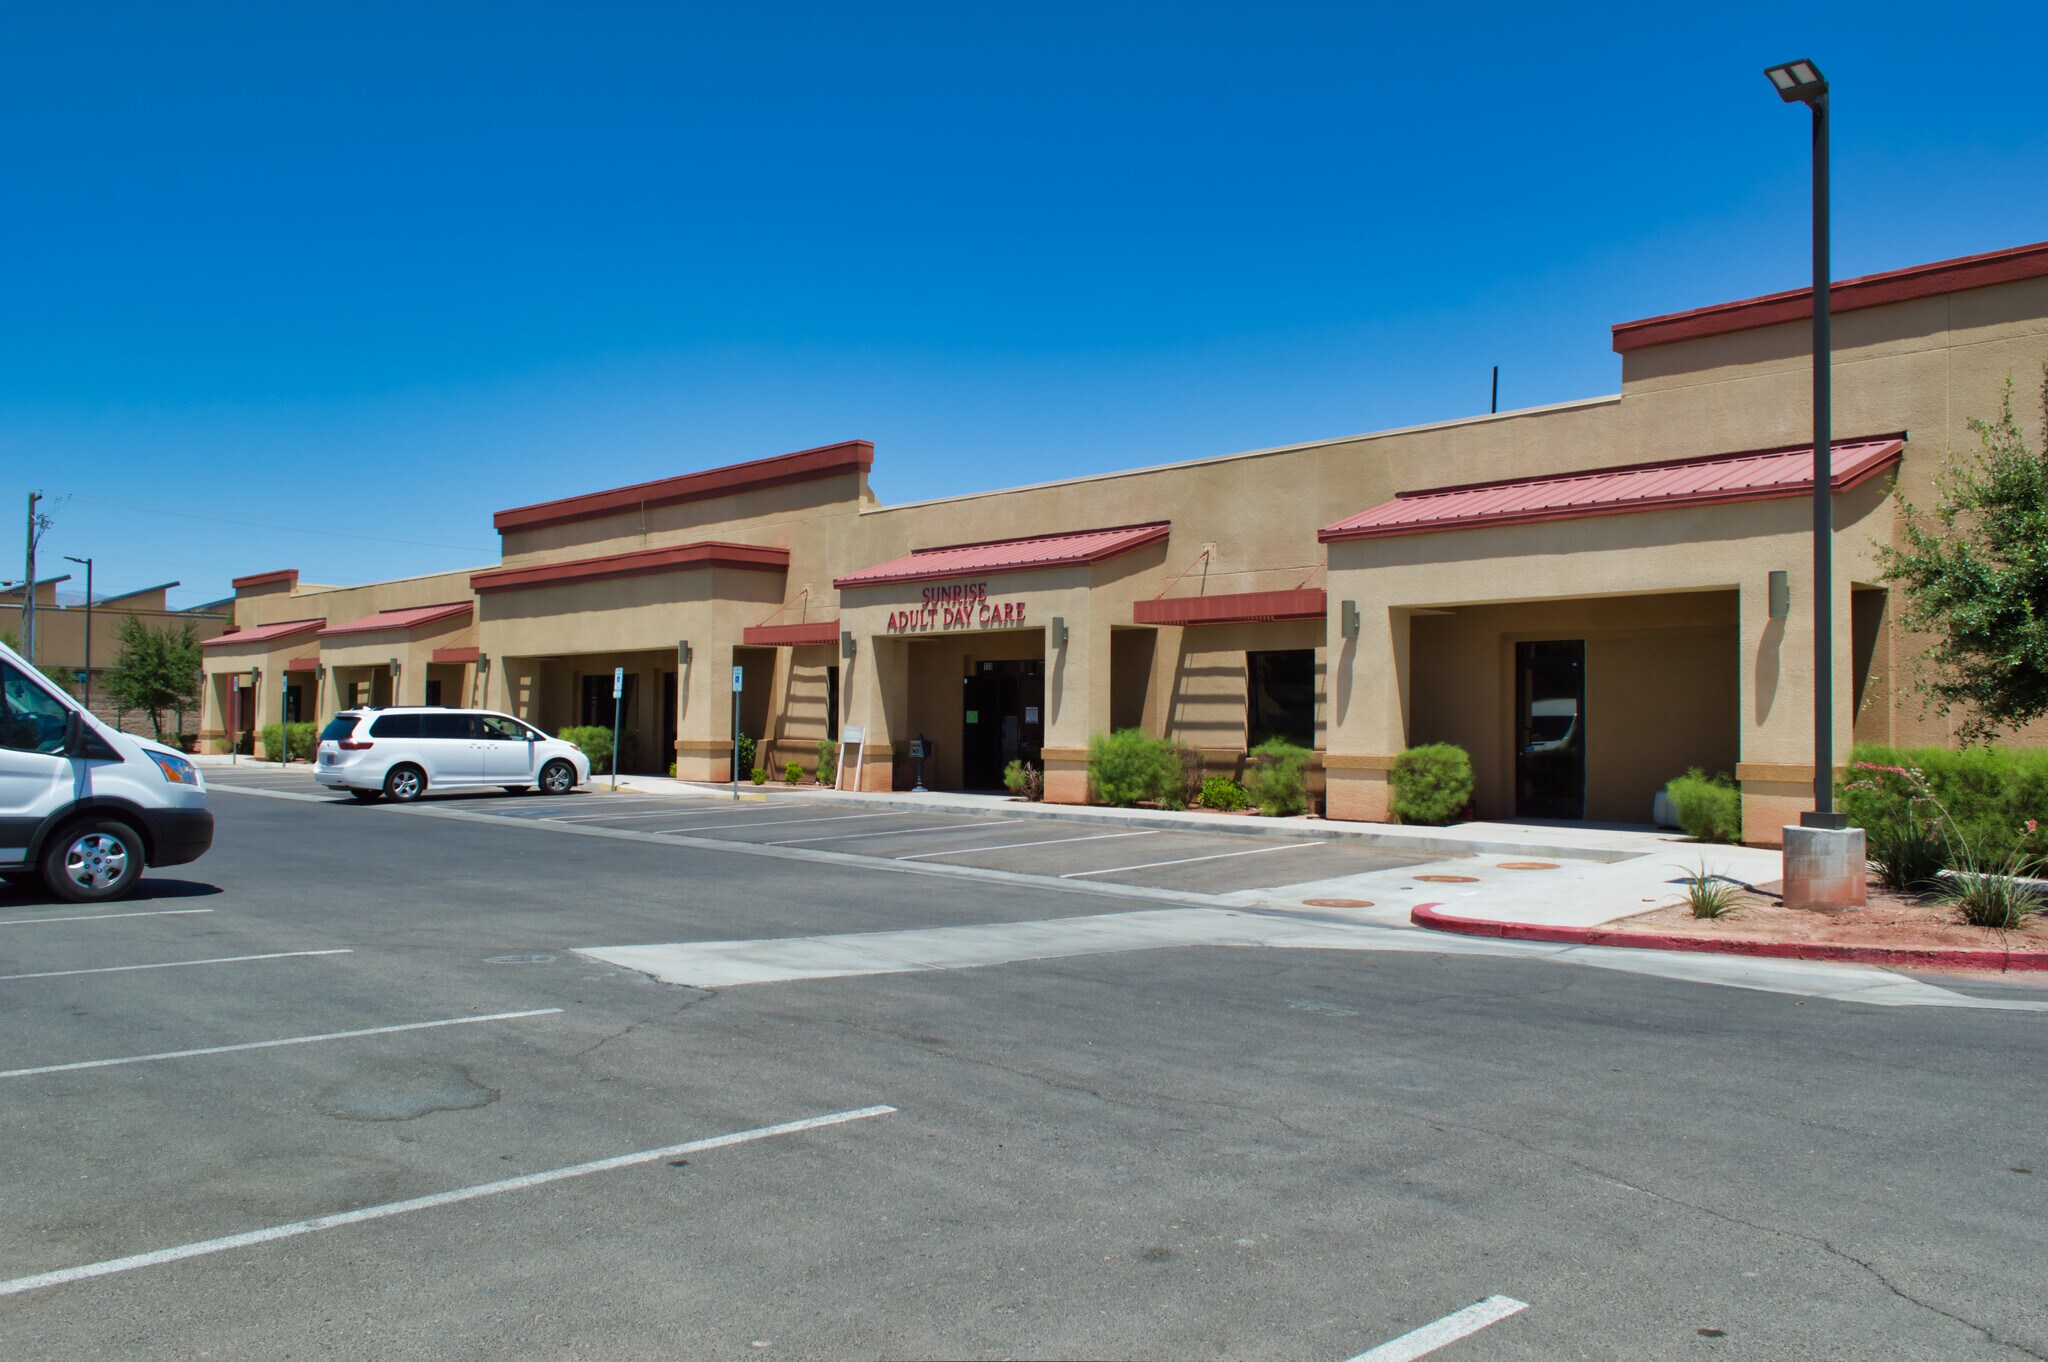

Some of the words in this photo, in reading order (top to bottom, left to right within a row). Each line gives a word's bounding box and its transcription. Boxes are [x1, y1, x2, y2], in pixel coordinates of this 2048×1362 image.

[922, 583, 987, 606] SUNRISE
[888, 608, 938, 629] ADULT
[943, 605, 974, 626] DAY
[979, 602, 1026, 623] CARE
